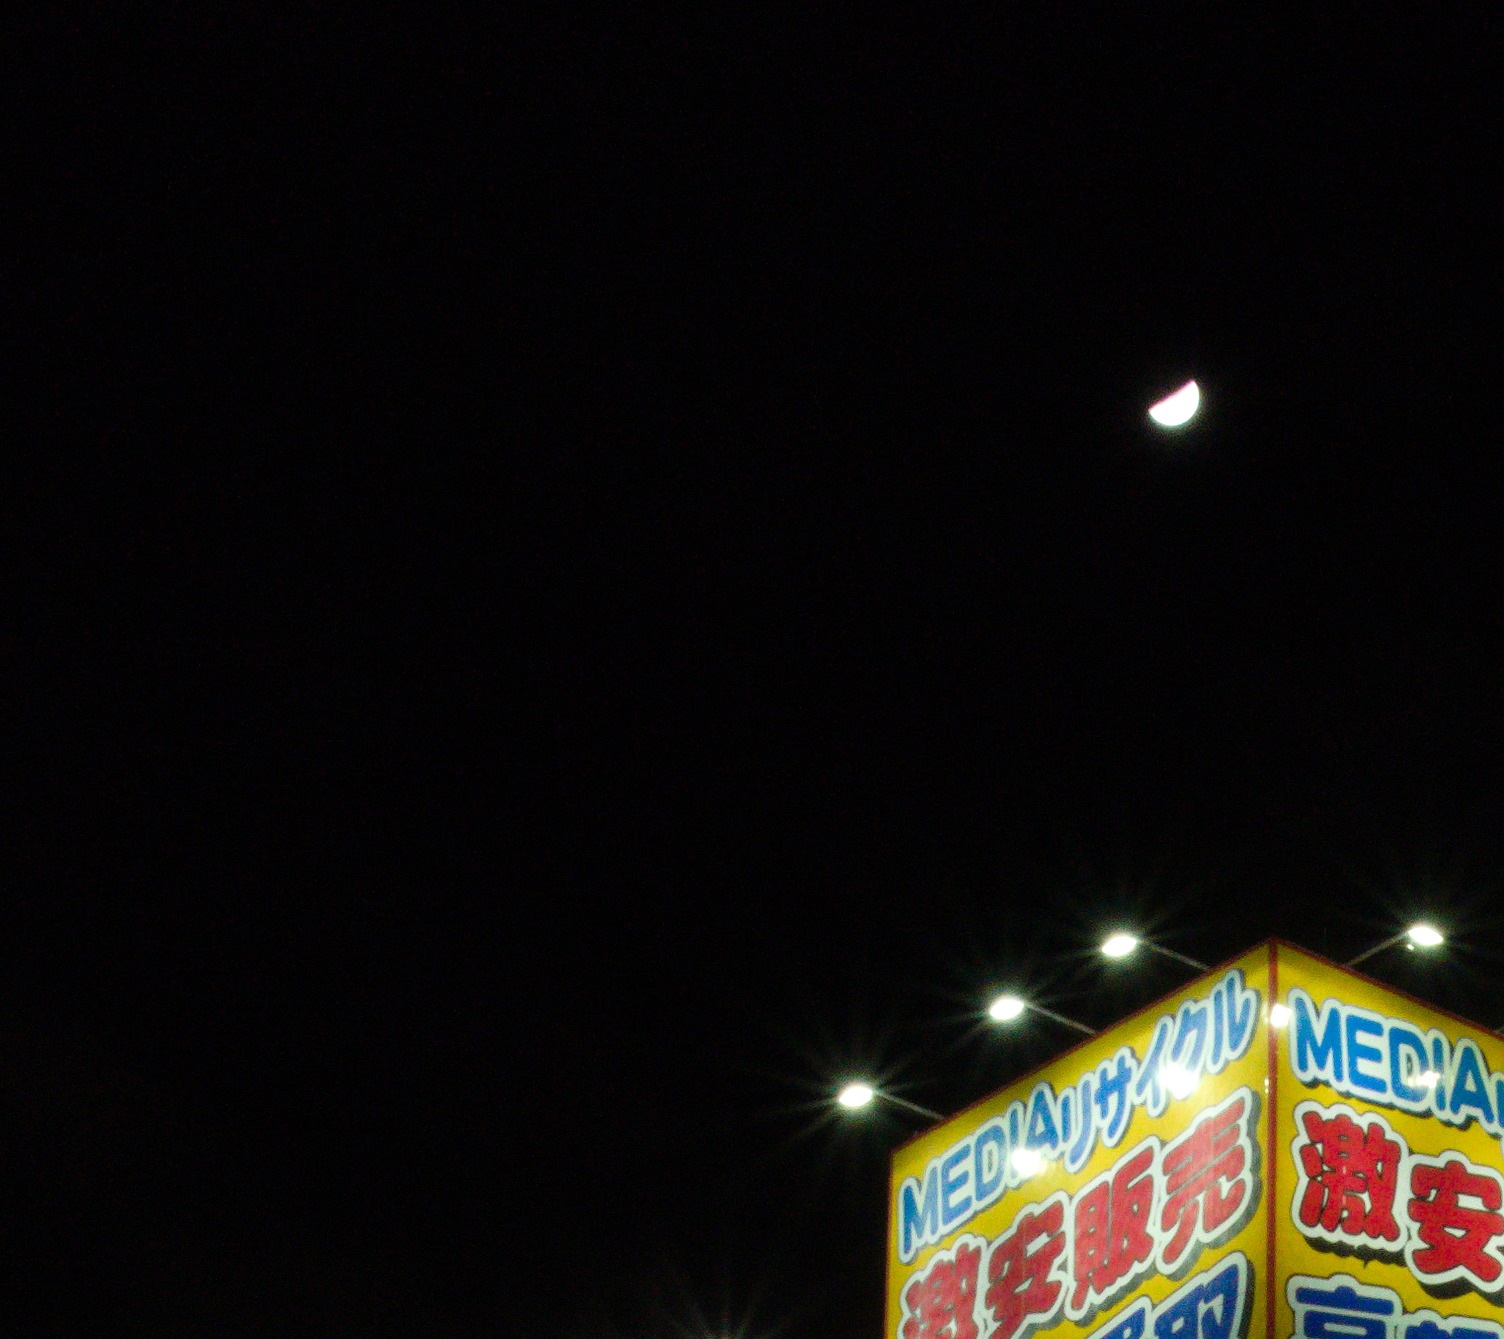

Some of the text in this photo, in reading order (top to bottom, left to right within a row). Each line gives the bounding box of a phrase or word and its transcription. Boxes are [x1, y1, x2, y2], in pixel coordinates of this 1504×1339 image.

[901, 968, 1257, 1263] MEDIAリサイクル
